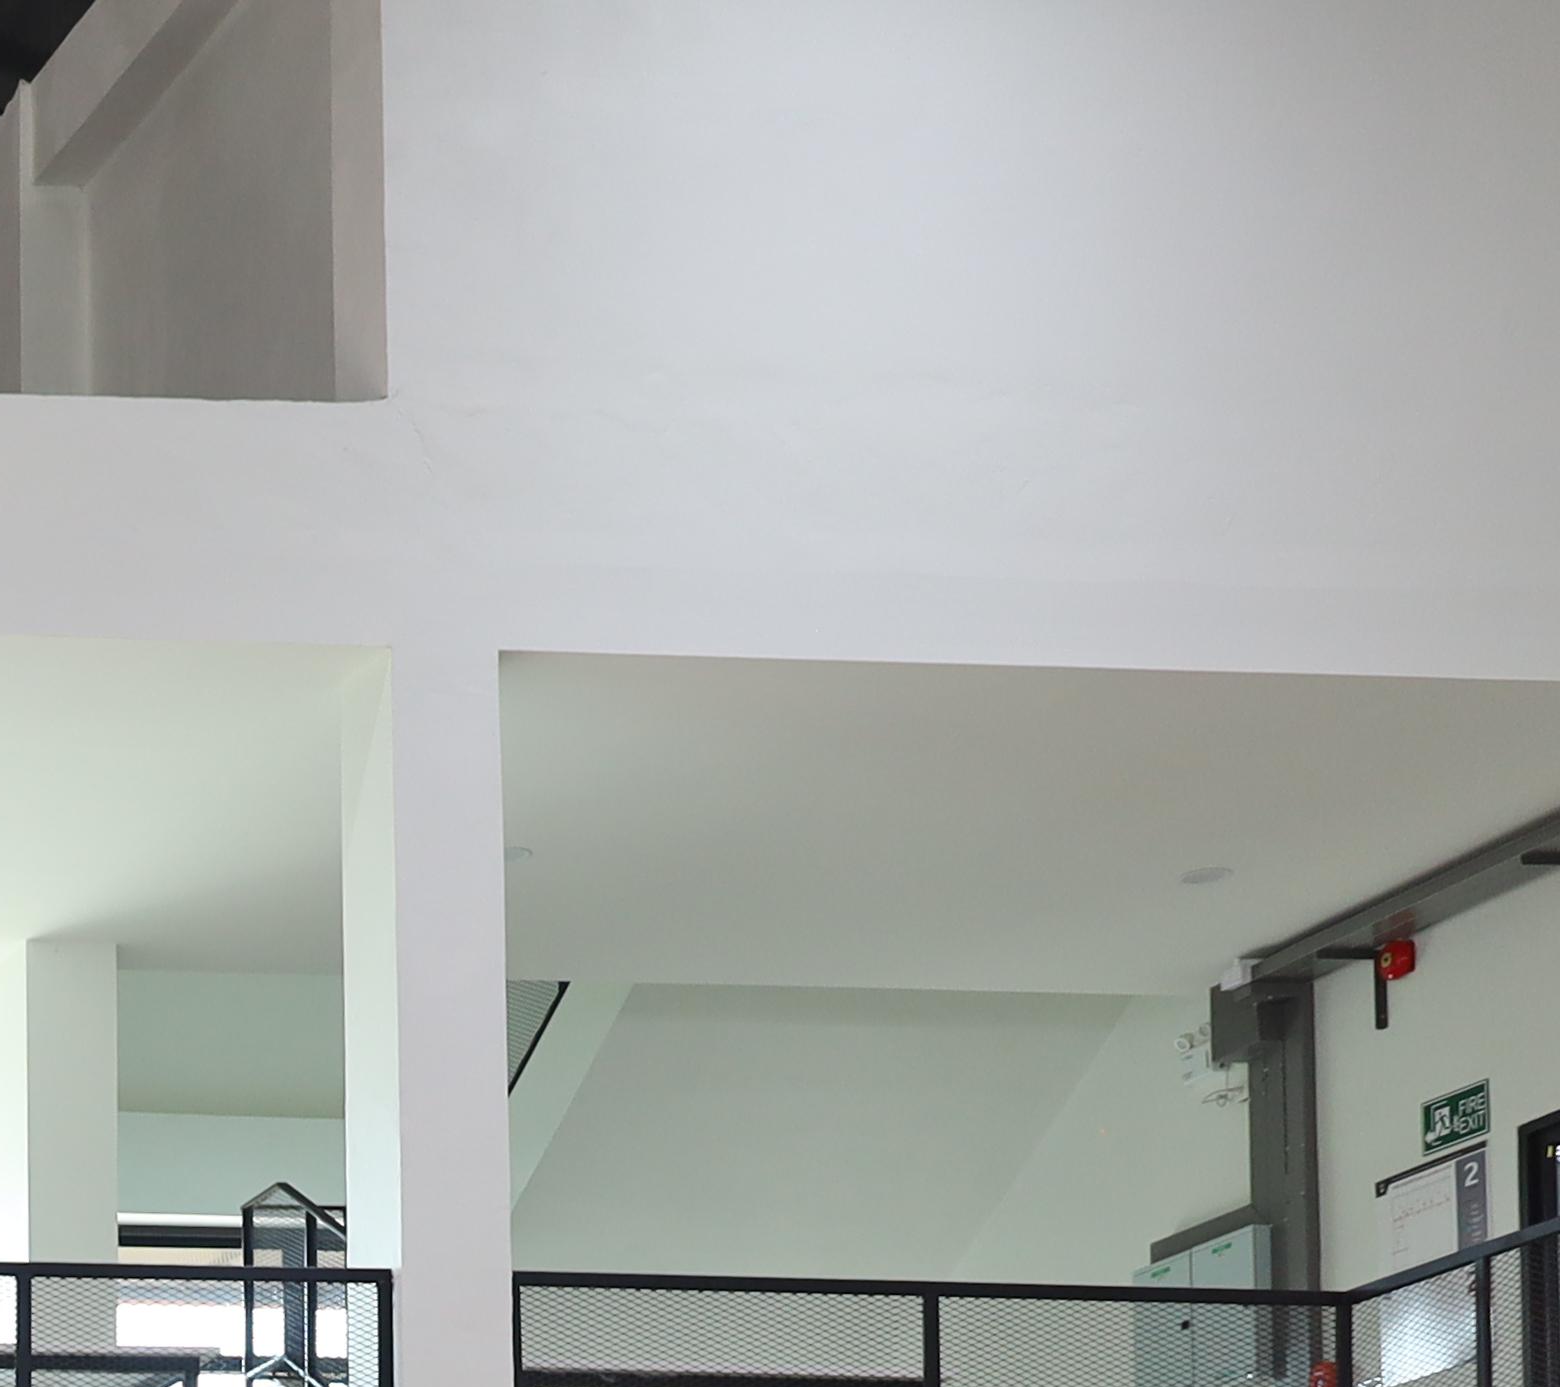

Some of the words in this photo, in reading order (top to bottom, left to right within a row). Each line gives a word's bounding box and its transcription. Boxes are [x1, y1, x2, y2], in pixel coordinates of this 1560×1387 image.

[1458, 1093, 1486, 1115] FIRE
[1459, 1111, 1485, 1134] EXIT
[1463, 1161, 1479, 1187] 2
